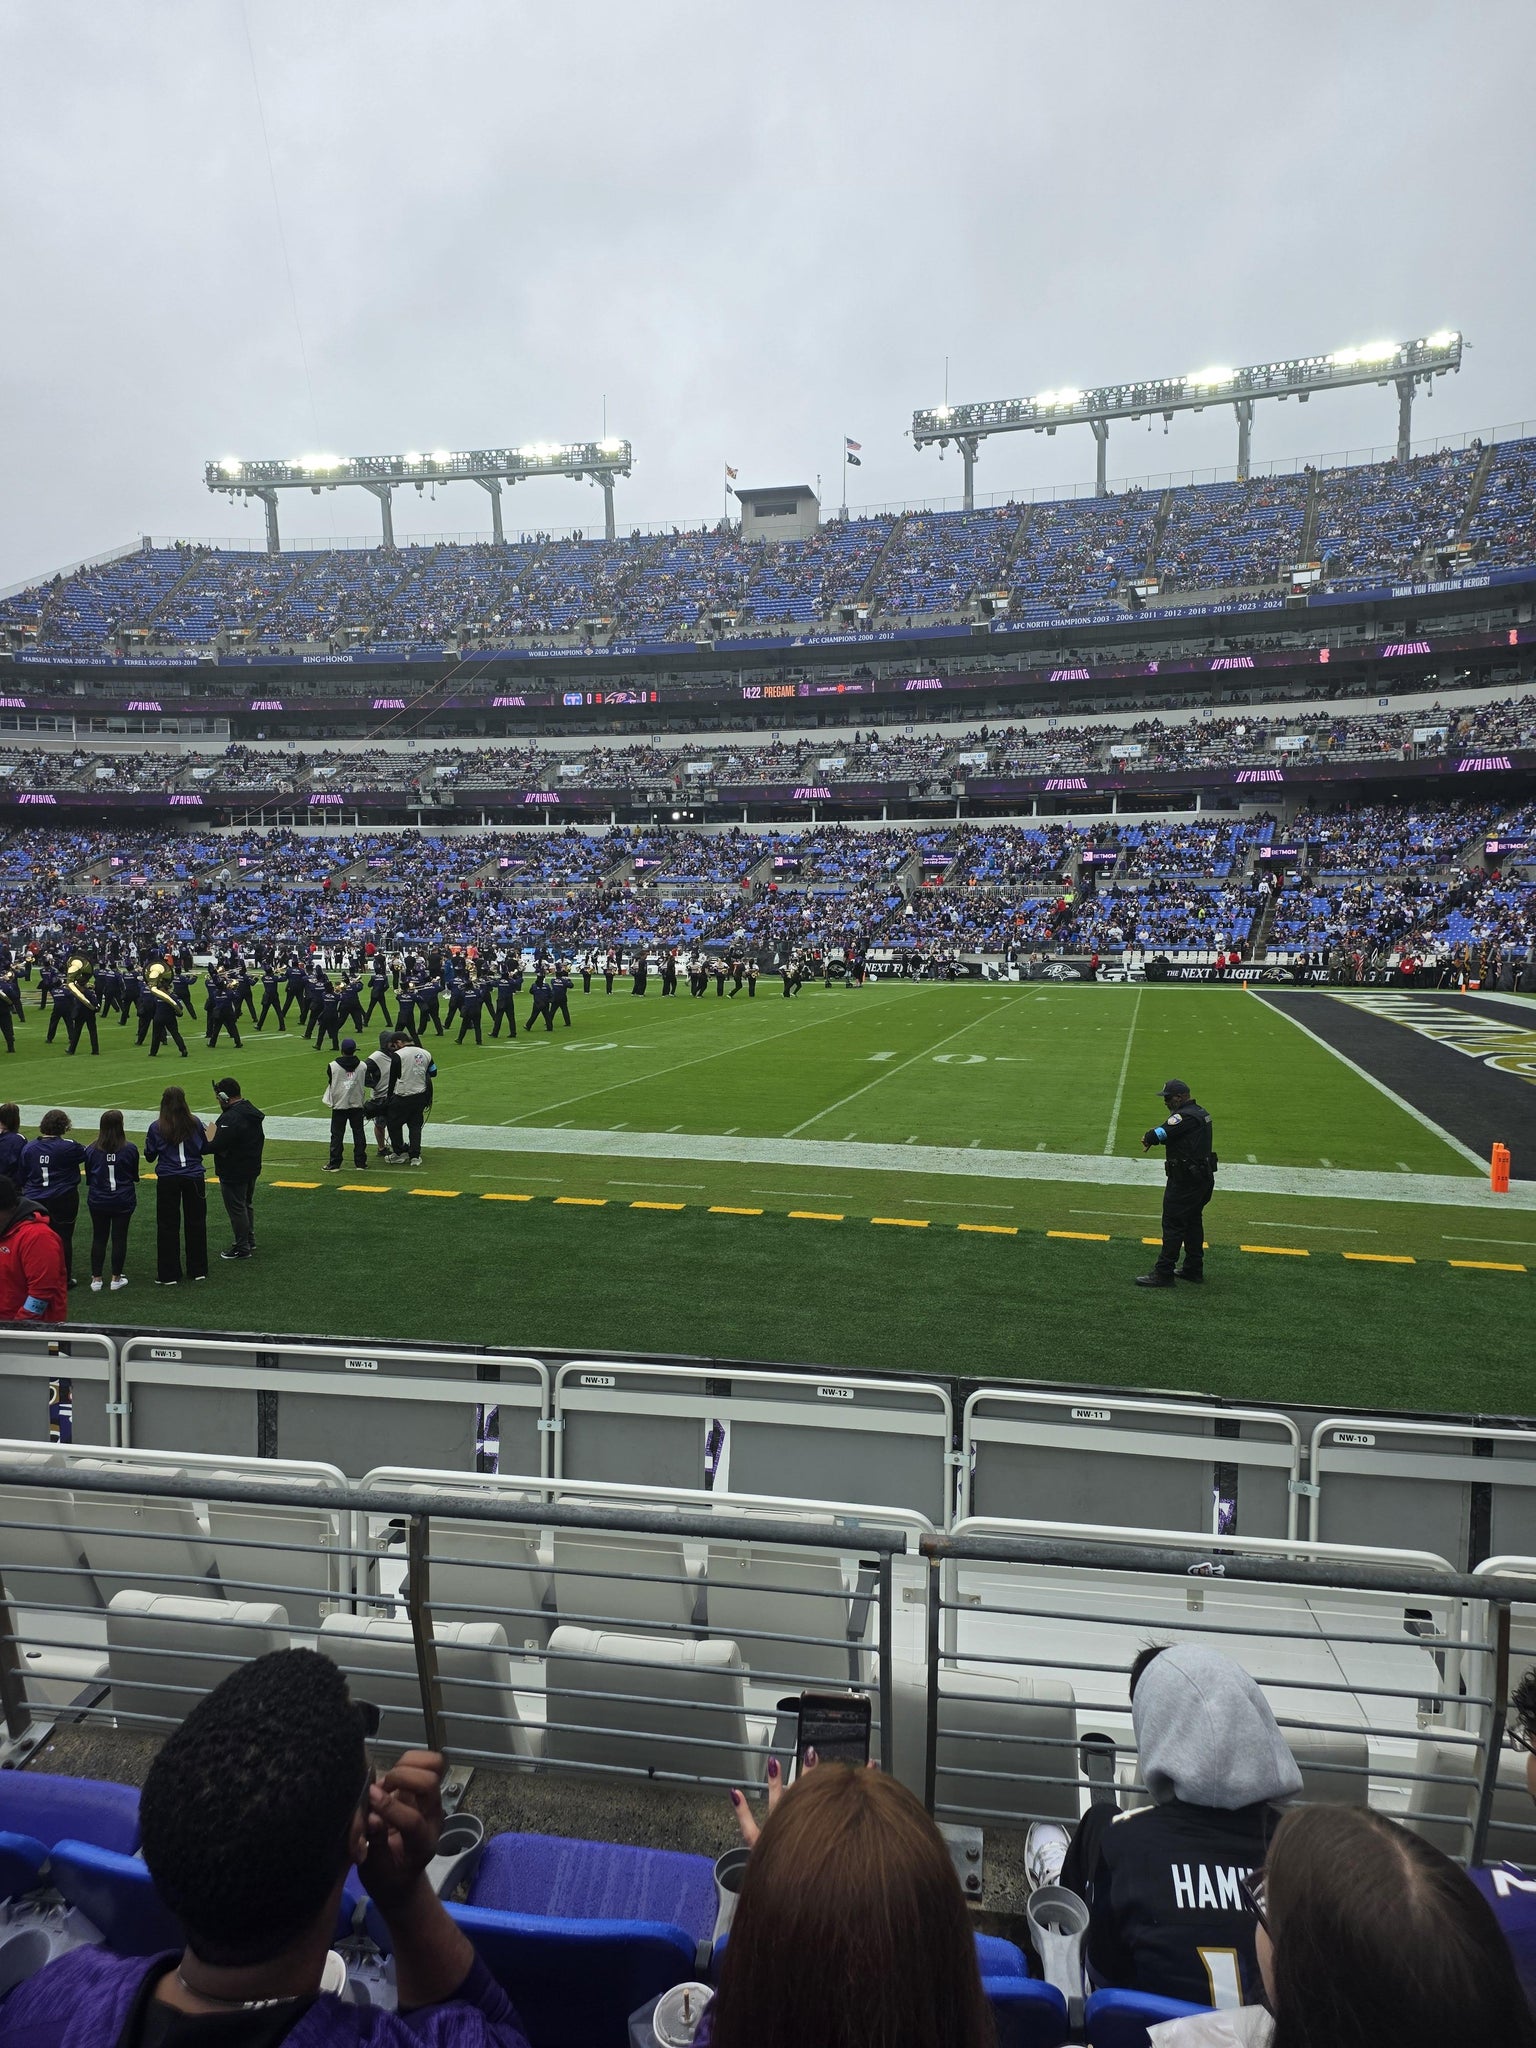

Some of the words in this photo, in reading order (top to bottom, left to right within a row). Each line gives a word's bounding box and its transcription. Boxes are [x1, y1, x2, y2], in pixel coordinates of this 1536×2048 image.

[1391, 588, 1413, 598] THANK
[1413, 585, 1427, 595] YOU
[1427, 580, 1462, 594] FRONTLINE
[1462, 576, 1490, 589] HEROES!
[1012, 622, 1025, 630] AFC
[1026, 621, 1050, 629] NORTH
[1050, 617, 1091, 627] CHAMPIONS
[1093, 615, 1110, 623] 2003
[1116, 613, 1133, 622] 2006
[1140, 611, 1157, 620] 2011
[1163, 609, 1182, 618] 2012
[1188, 607, 1207, 616] 2018
[1212, 604, 1232, 614] 2019
[1237, 602, 1257, 611] 2023
[1263, 600, 1283, 609] 2024
[821, 635, 857, 643] CHAMPIONS
[550, 649, 583, 657] CHAMPIONS
[53, 657, 73, 665] YANDA
[303, 656, 321, 664] RING
[325, 655, 353, 663] HONOR
[764, 685, 796, 698] PREGAME
[1458, 756, 1512, 772] UPRISING
[1236, 769, 1284, 783] UPRISING
[1045, 777, 1088, 791] UPRISING
[865, 963, 890, 973] NEXT
[1180, 968, 1212, 979] NEXT
[39, 1155, 50, 1164] GO
[106, 1153, 116, 1162] GO
[41, 1166, 49, 1187] 1
[107, 1165, 117, 1191] 1
[155, 1350, 177, 1358] NW-15
[585, 1377, 609, 1385] NW-13
[822, 1388, 848, 1397] NW-12
[1076, 1410, 1103, 1418] NW-11
[1339, 1434, 1368, 1443] NW-10
